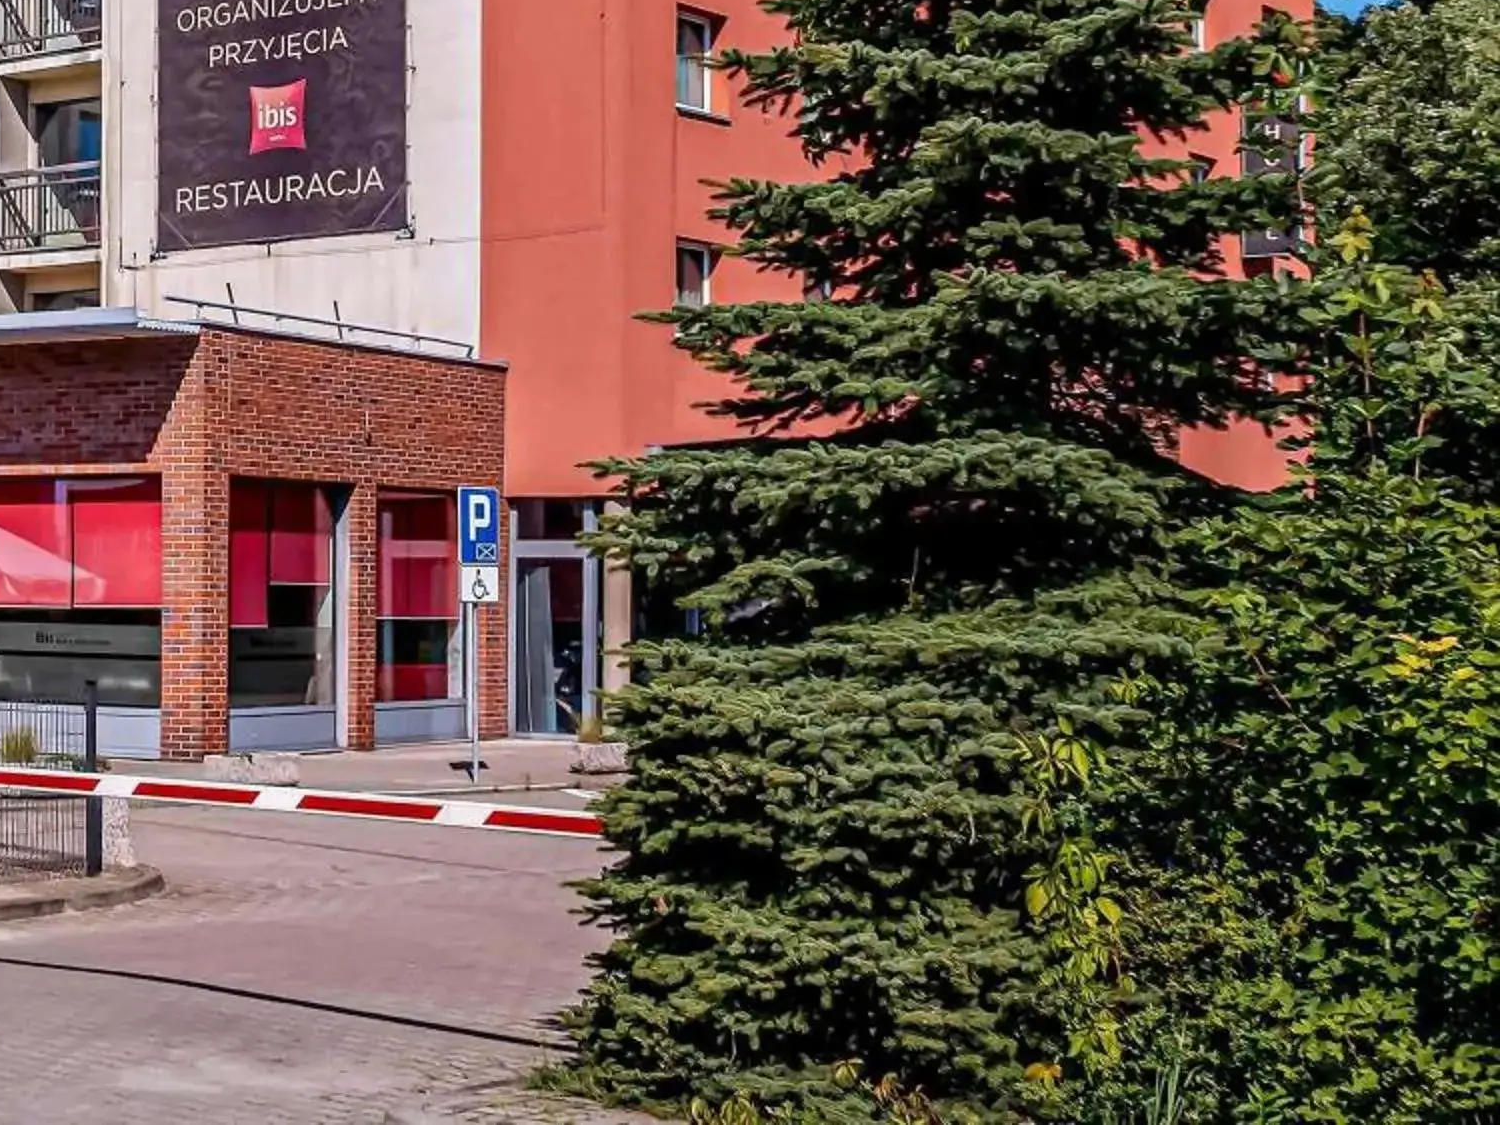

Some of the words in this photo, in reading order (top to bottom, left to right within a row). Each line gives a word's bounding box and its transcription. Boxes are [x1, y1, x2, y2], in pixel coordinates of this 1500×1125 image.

[208, 26, 349, 68] PRZYJĘCIA
[257, 101, 298, 129] ibis
[176, 166, 385, 213] RESTAURACJA
[469, 494, 490, 541] P
